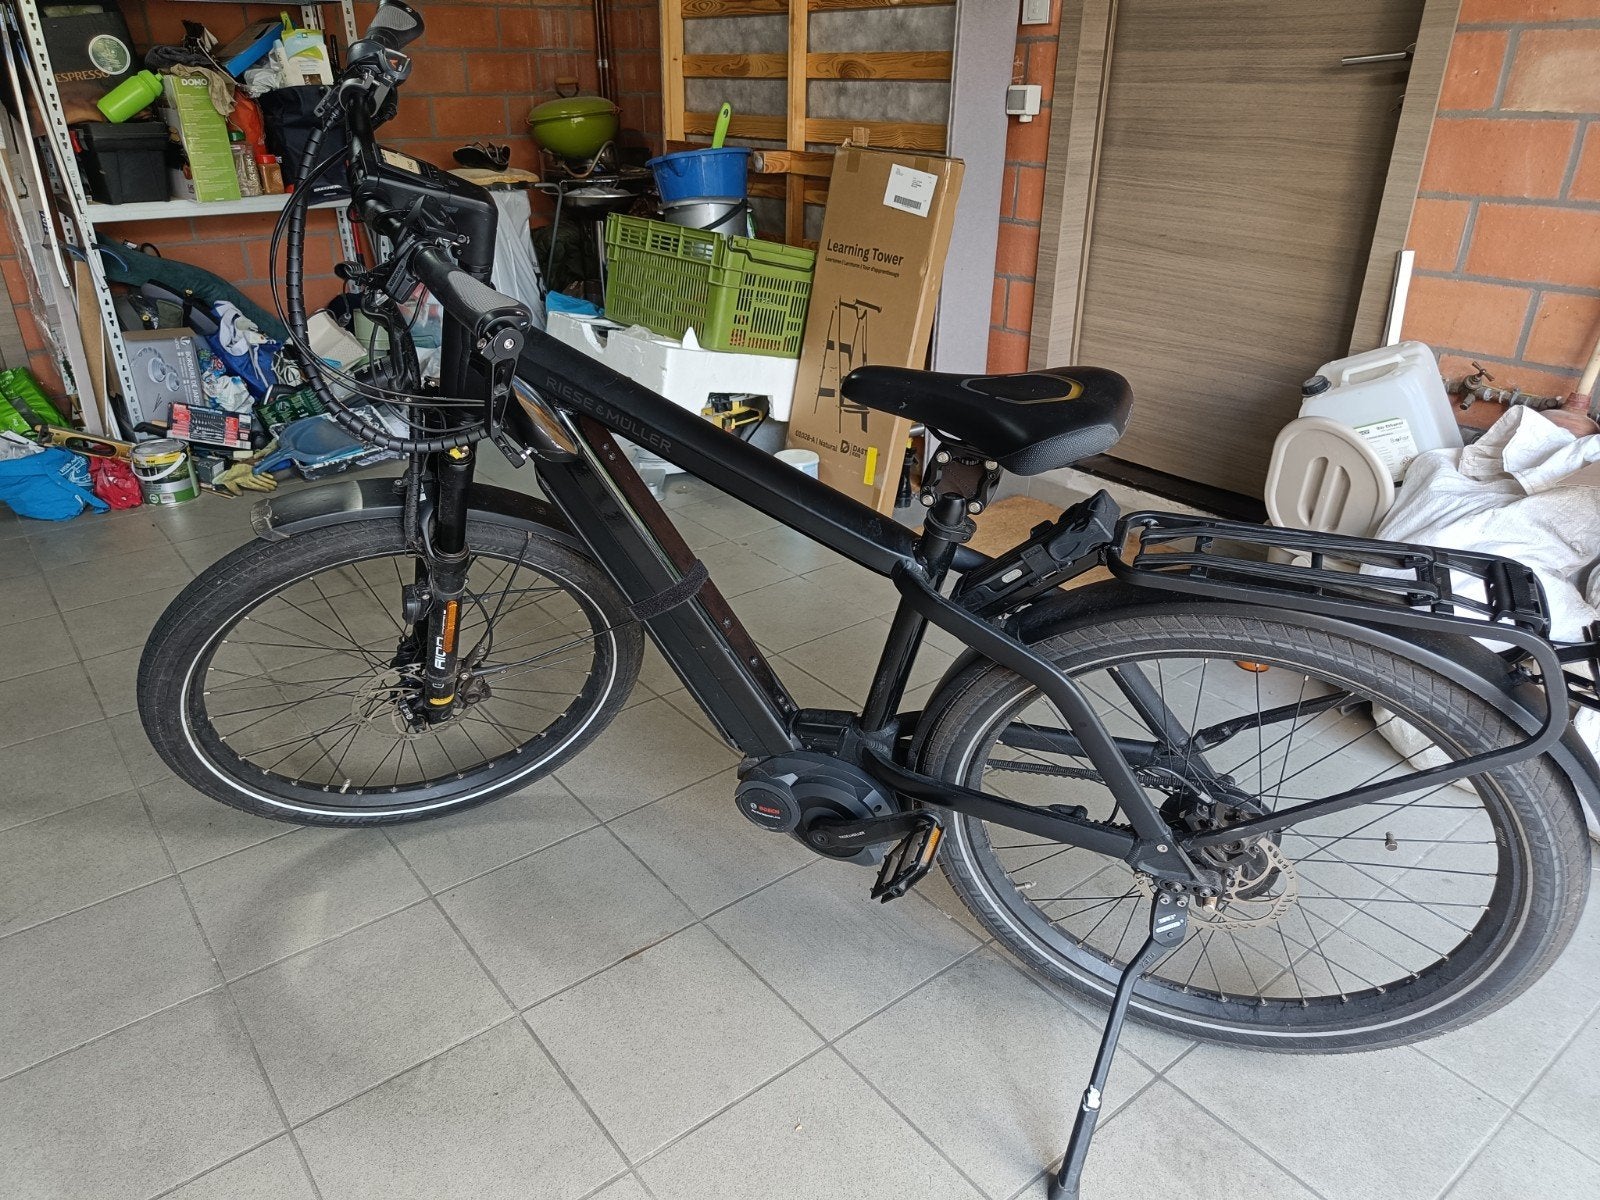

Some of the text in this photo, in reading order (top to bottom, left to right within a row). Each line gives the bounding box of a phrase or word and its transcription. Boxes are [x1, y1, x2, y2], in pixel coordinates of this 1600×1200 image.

[181, 78, 208, 87] DOMO
[827, 238, 905, 266] Learning Tower
[819, 439, 838, 452] Natural
[758, 805, 780, 815] BOSCH
